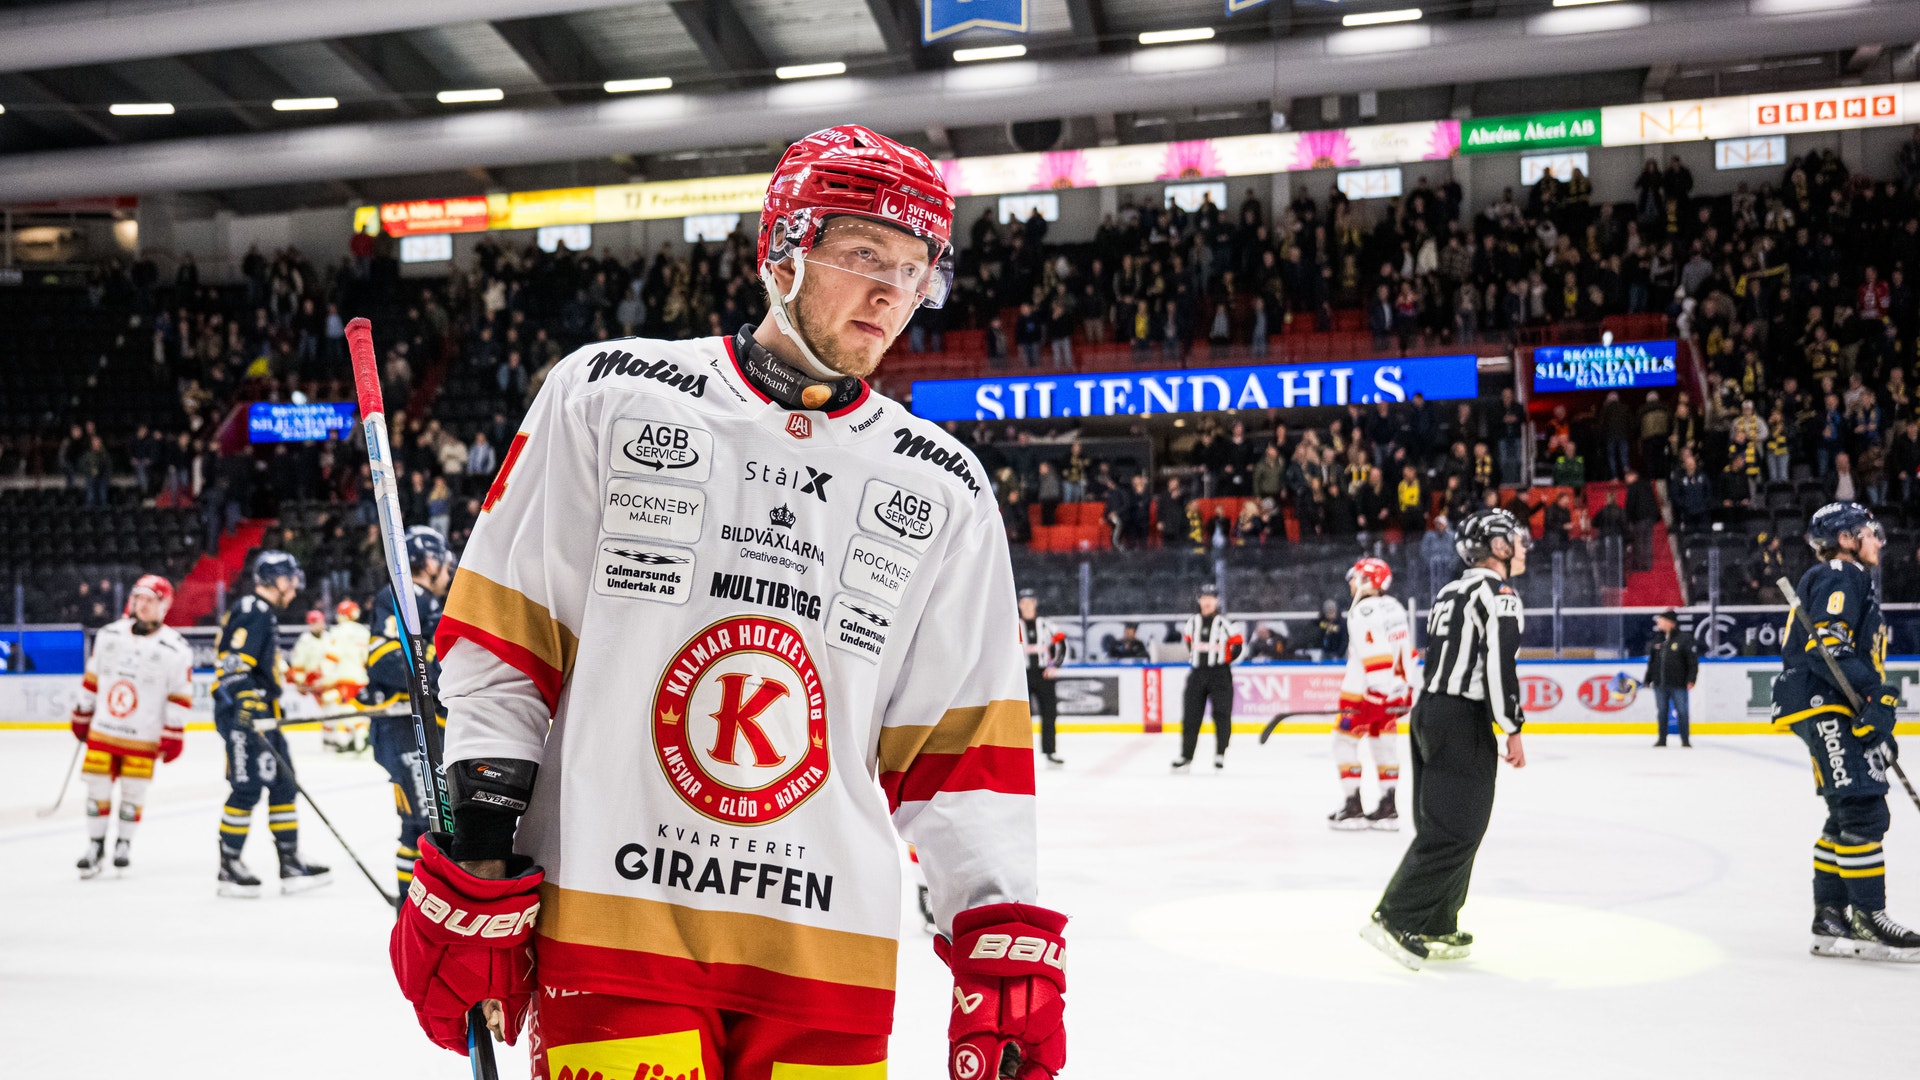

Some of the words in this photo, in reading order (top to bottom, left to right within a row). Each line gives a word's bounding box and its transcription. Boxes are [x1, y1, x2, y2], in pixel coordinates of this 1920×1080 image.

[1760, 97, 1894, 123] CRAMO
[1569, 119, 1595, 138] AB
[907, 203, 948, 229] SVENSKA
[587, 350, 709, 398] Molins
[746, 360, 791, 395] Sparbank
[762, 353, 795, 383] Ålems
[637, 424, 689, 450] AGB
[636, 445, 686, 462] SERVICE
[609, 493, 699, 516] ROCKNEBY
[888, 490, 932, 522] AGB
[629, 511, 672, 526] MÅLERI
[885, 509, 926, 534] SERVICE
[721, 524, 824, 566] BILDVÄXLARNA
[740, 547, 778, 564] Creative
[605, 564, 681, 584] Calmarsunds
[607, 578, 656, 593] Undertak
[659, 583, 675, 595] AB
[871, 570, 900, 591] MÅLERI
[709, 571, 822, 622] MULTIBYGG
[1500, 598, 1517, 612] 72
[1826, 591, 1845, 615] 8
[414, 639, 423, 657] P92
[420, 675, 429, 696] FLEX
[666, 628, 733, 698] KALMAR
[738, 624, 806, 668] HOCKEY
[803, 668, 822, 720] CLUB
[706, 672, 790, 768] K
[1816, 717, 1853, 788] Dialect
[663, 746, 702, 798] ANSVAR
[775, 766, 824, 810] HJÄRTA
[718, 796, 758, 817] GLÖD
[658, 824, 806, 860] KVARTERET
[614, 842, 834, 912] GIRAFFEN
